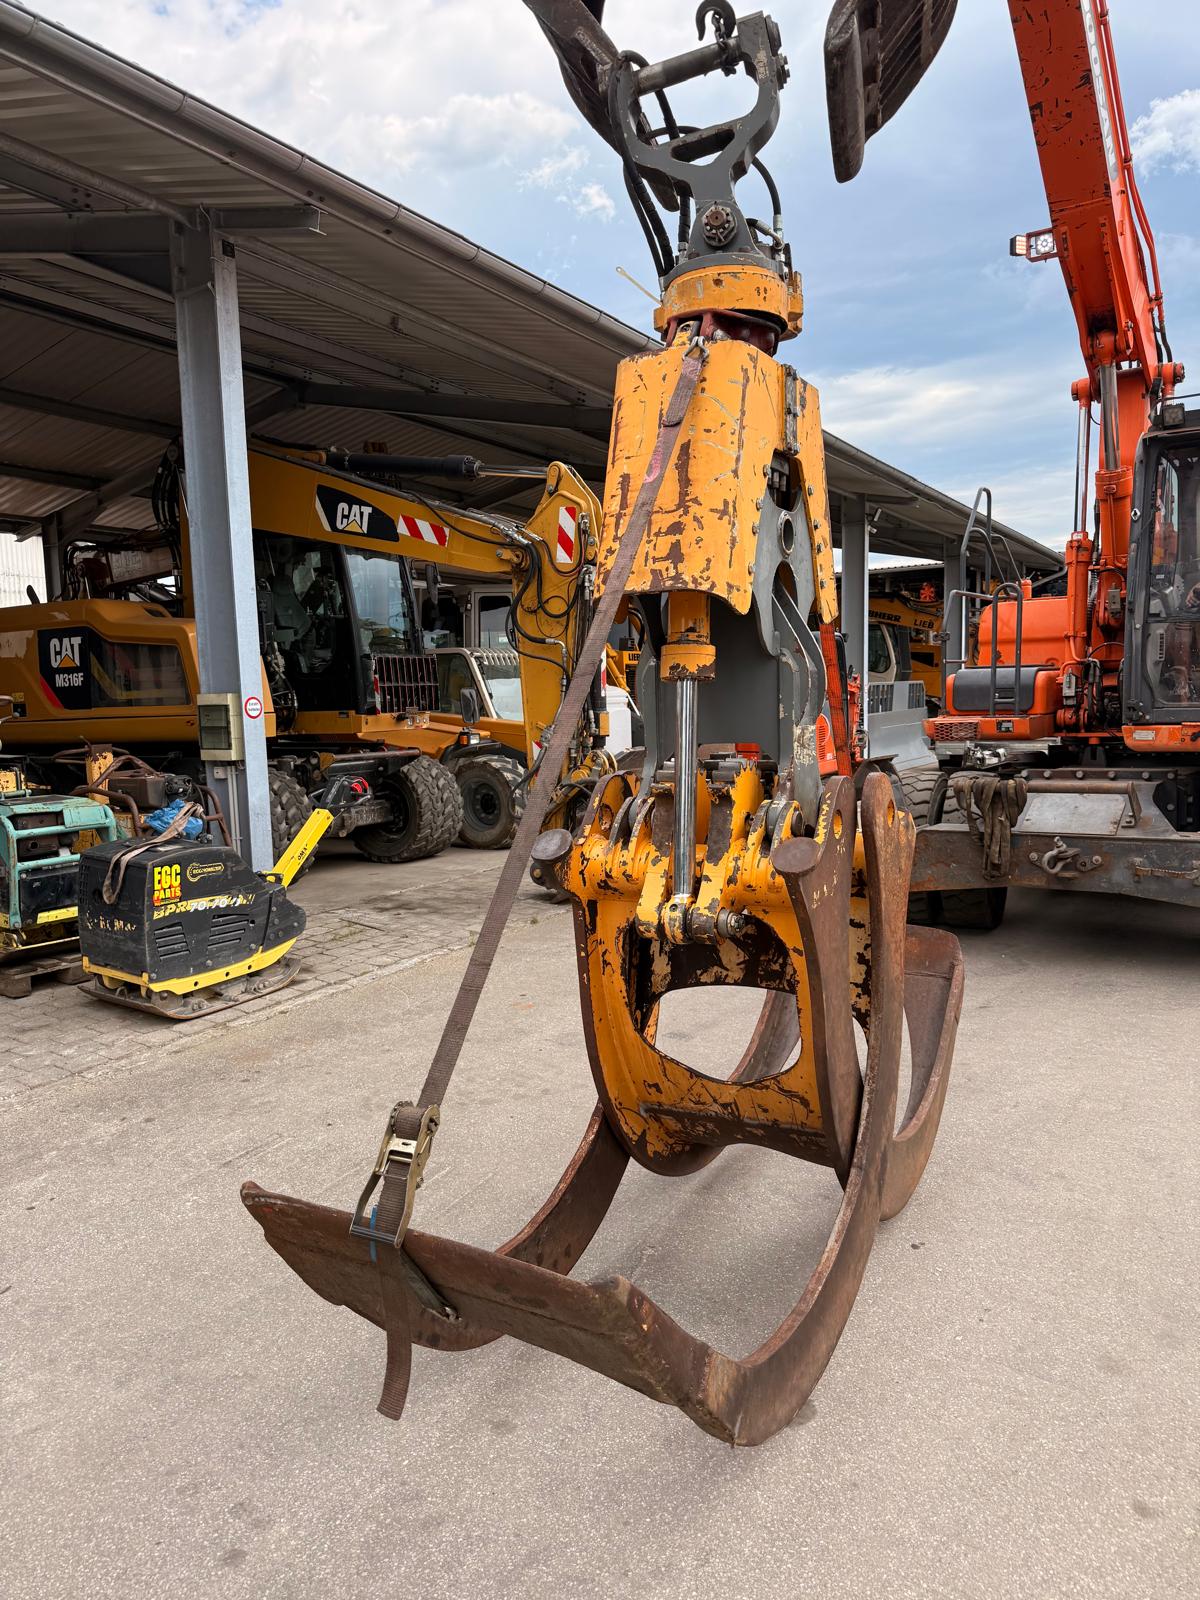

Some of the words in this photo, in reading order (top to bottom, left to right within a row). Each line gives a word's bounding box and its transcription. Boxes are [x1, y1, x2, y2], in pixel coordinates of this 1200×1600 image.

[336, 502, 372, 533] CAT
[50, 637, 81, 668] CAT
[55, 673, 84, 687] M316F
[154, 864, 181, 890] EGC
[154, 887, 181, 900] PARTS
